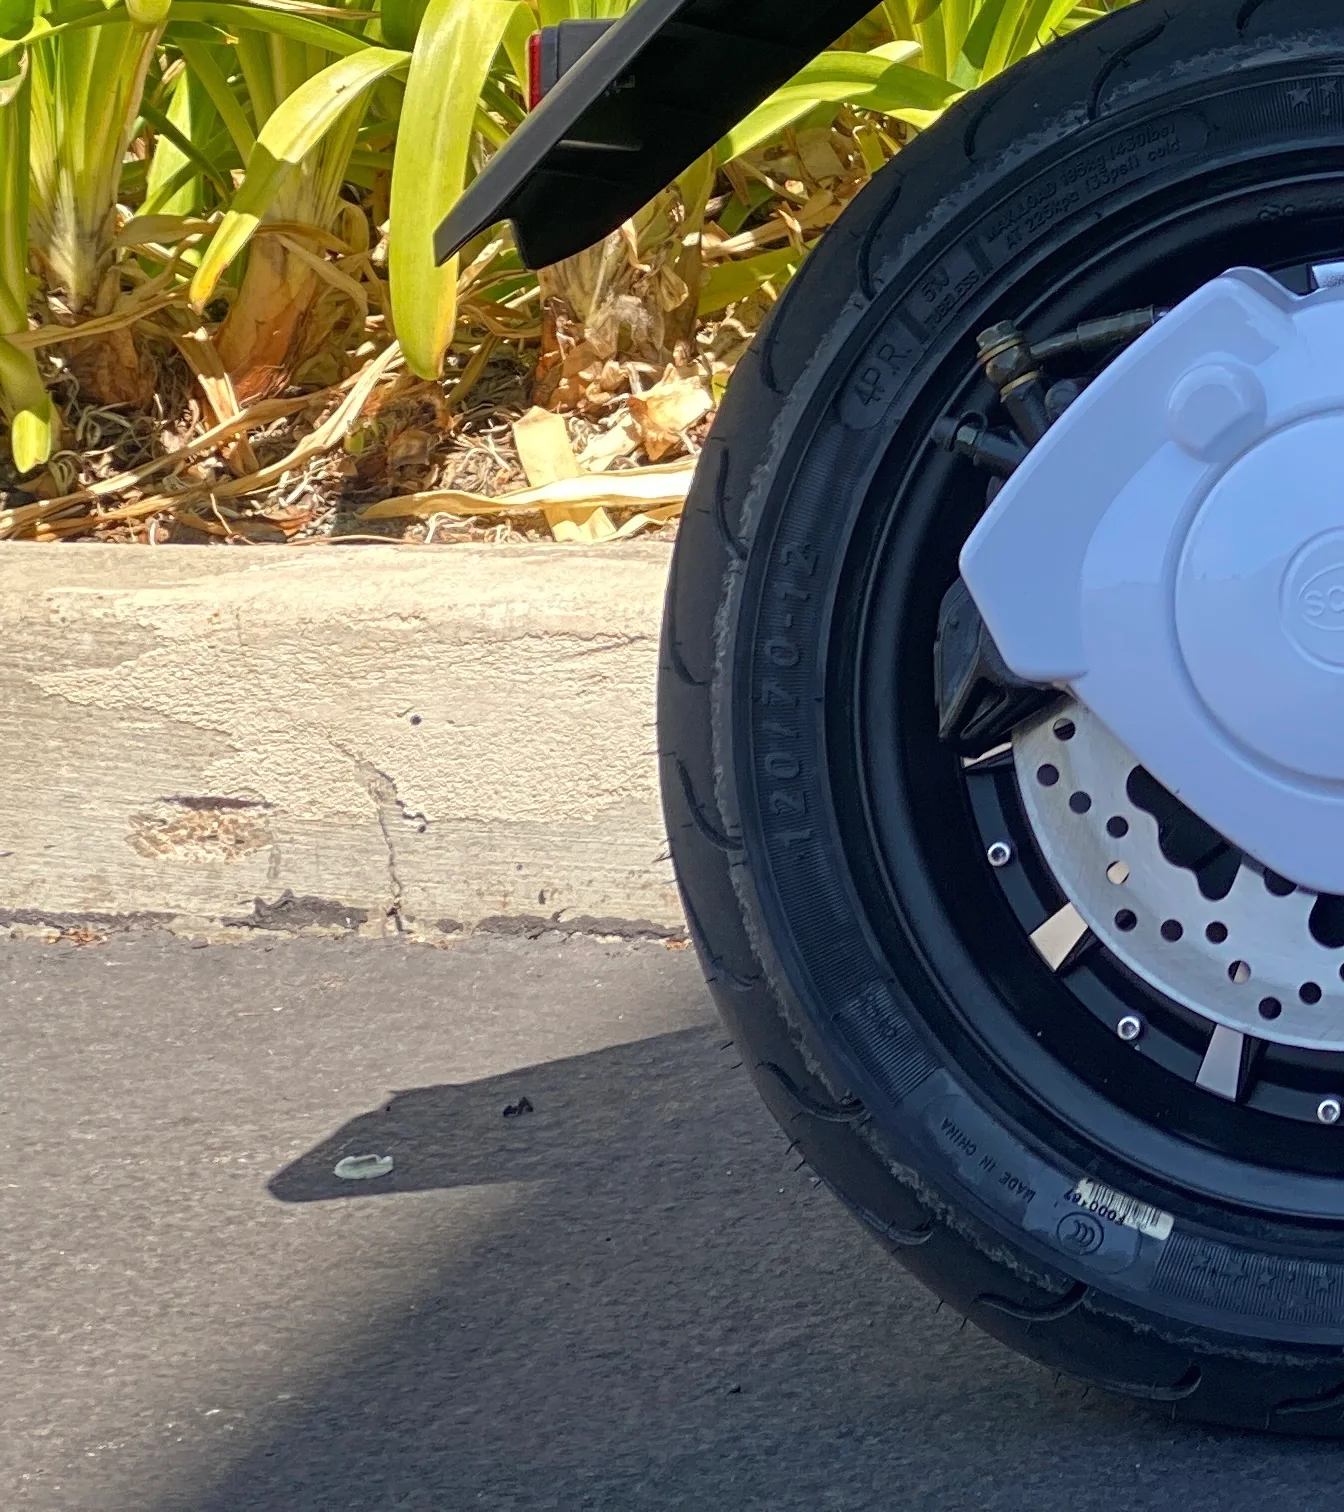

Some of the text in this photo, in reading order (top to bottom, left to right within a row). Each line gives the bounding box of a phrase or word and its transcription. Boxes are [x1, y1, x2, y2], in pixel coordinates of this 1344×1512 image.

[1146, 137, 1181, 161] cold
[923, 269, 979, 330] TUBELESS
[760, 538, 820, 850] 120/70-12
[939, 1116, 1036, 1204] MADE IN CHINA
